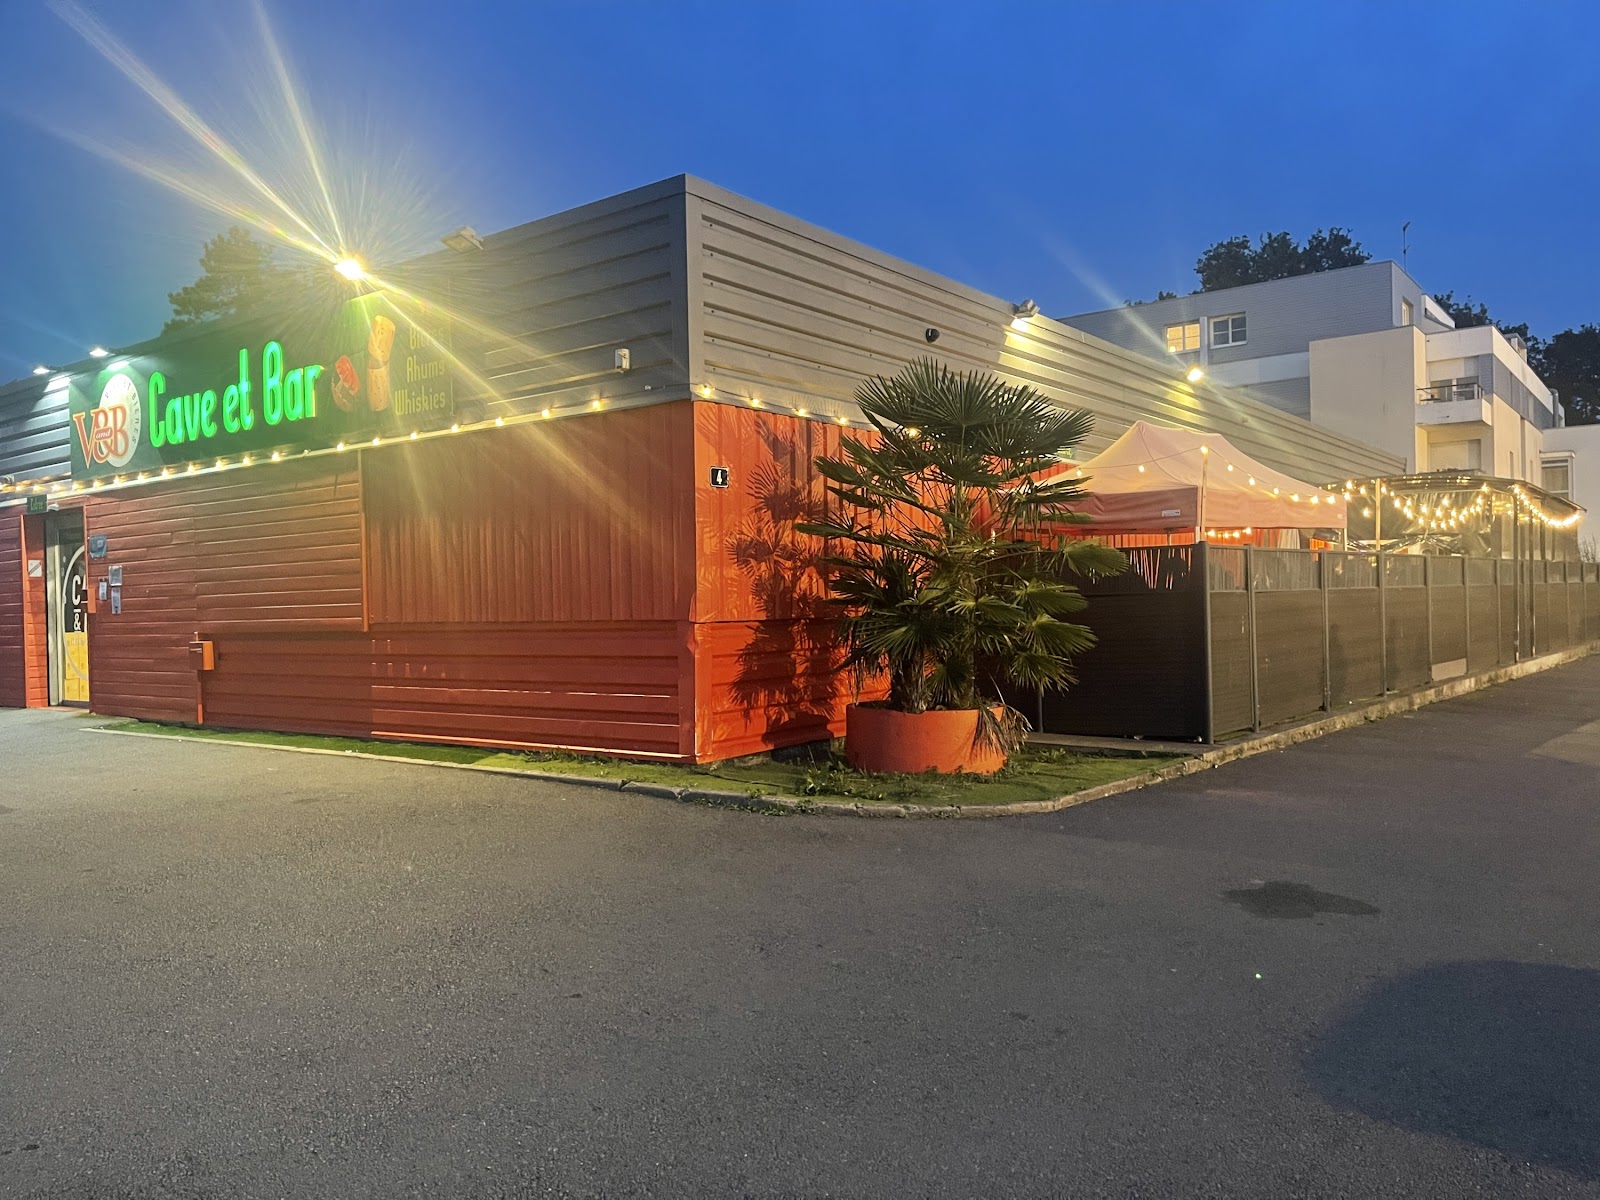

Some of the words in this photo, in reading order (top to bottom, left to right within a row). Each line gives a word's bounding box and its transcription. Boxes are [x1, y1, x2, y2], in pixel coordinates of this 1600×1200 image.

[406, 354, 445, 383] Rhums
[149, 372, 217, 448] Cave
[223, 348, 254, 433] et
[263, 341, 324, 426] Bar
[394, 385, 446, 416] Whiskies
[96, 428, 111, 439] and
[716, 469, 723, 485] 4
